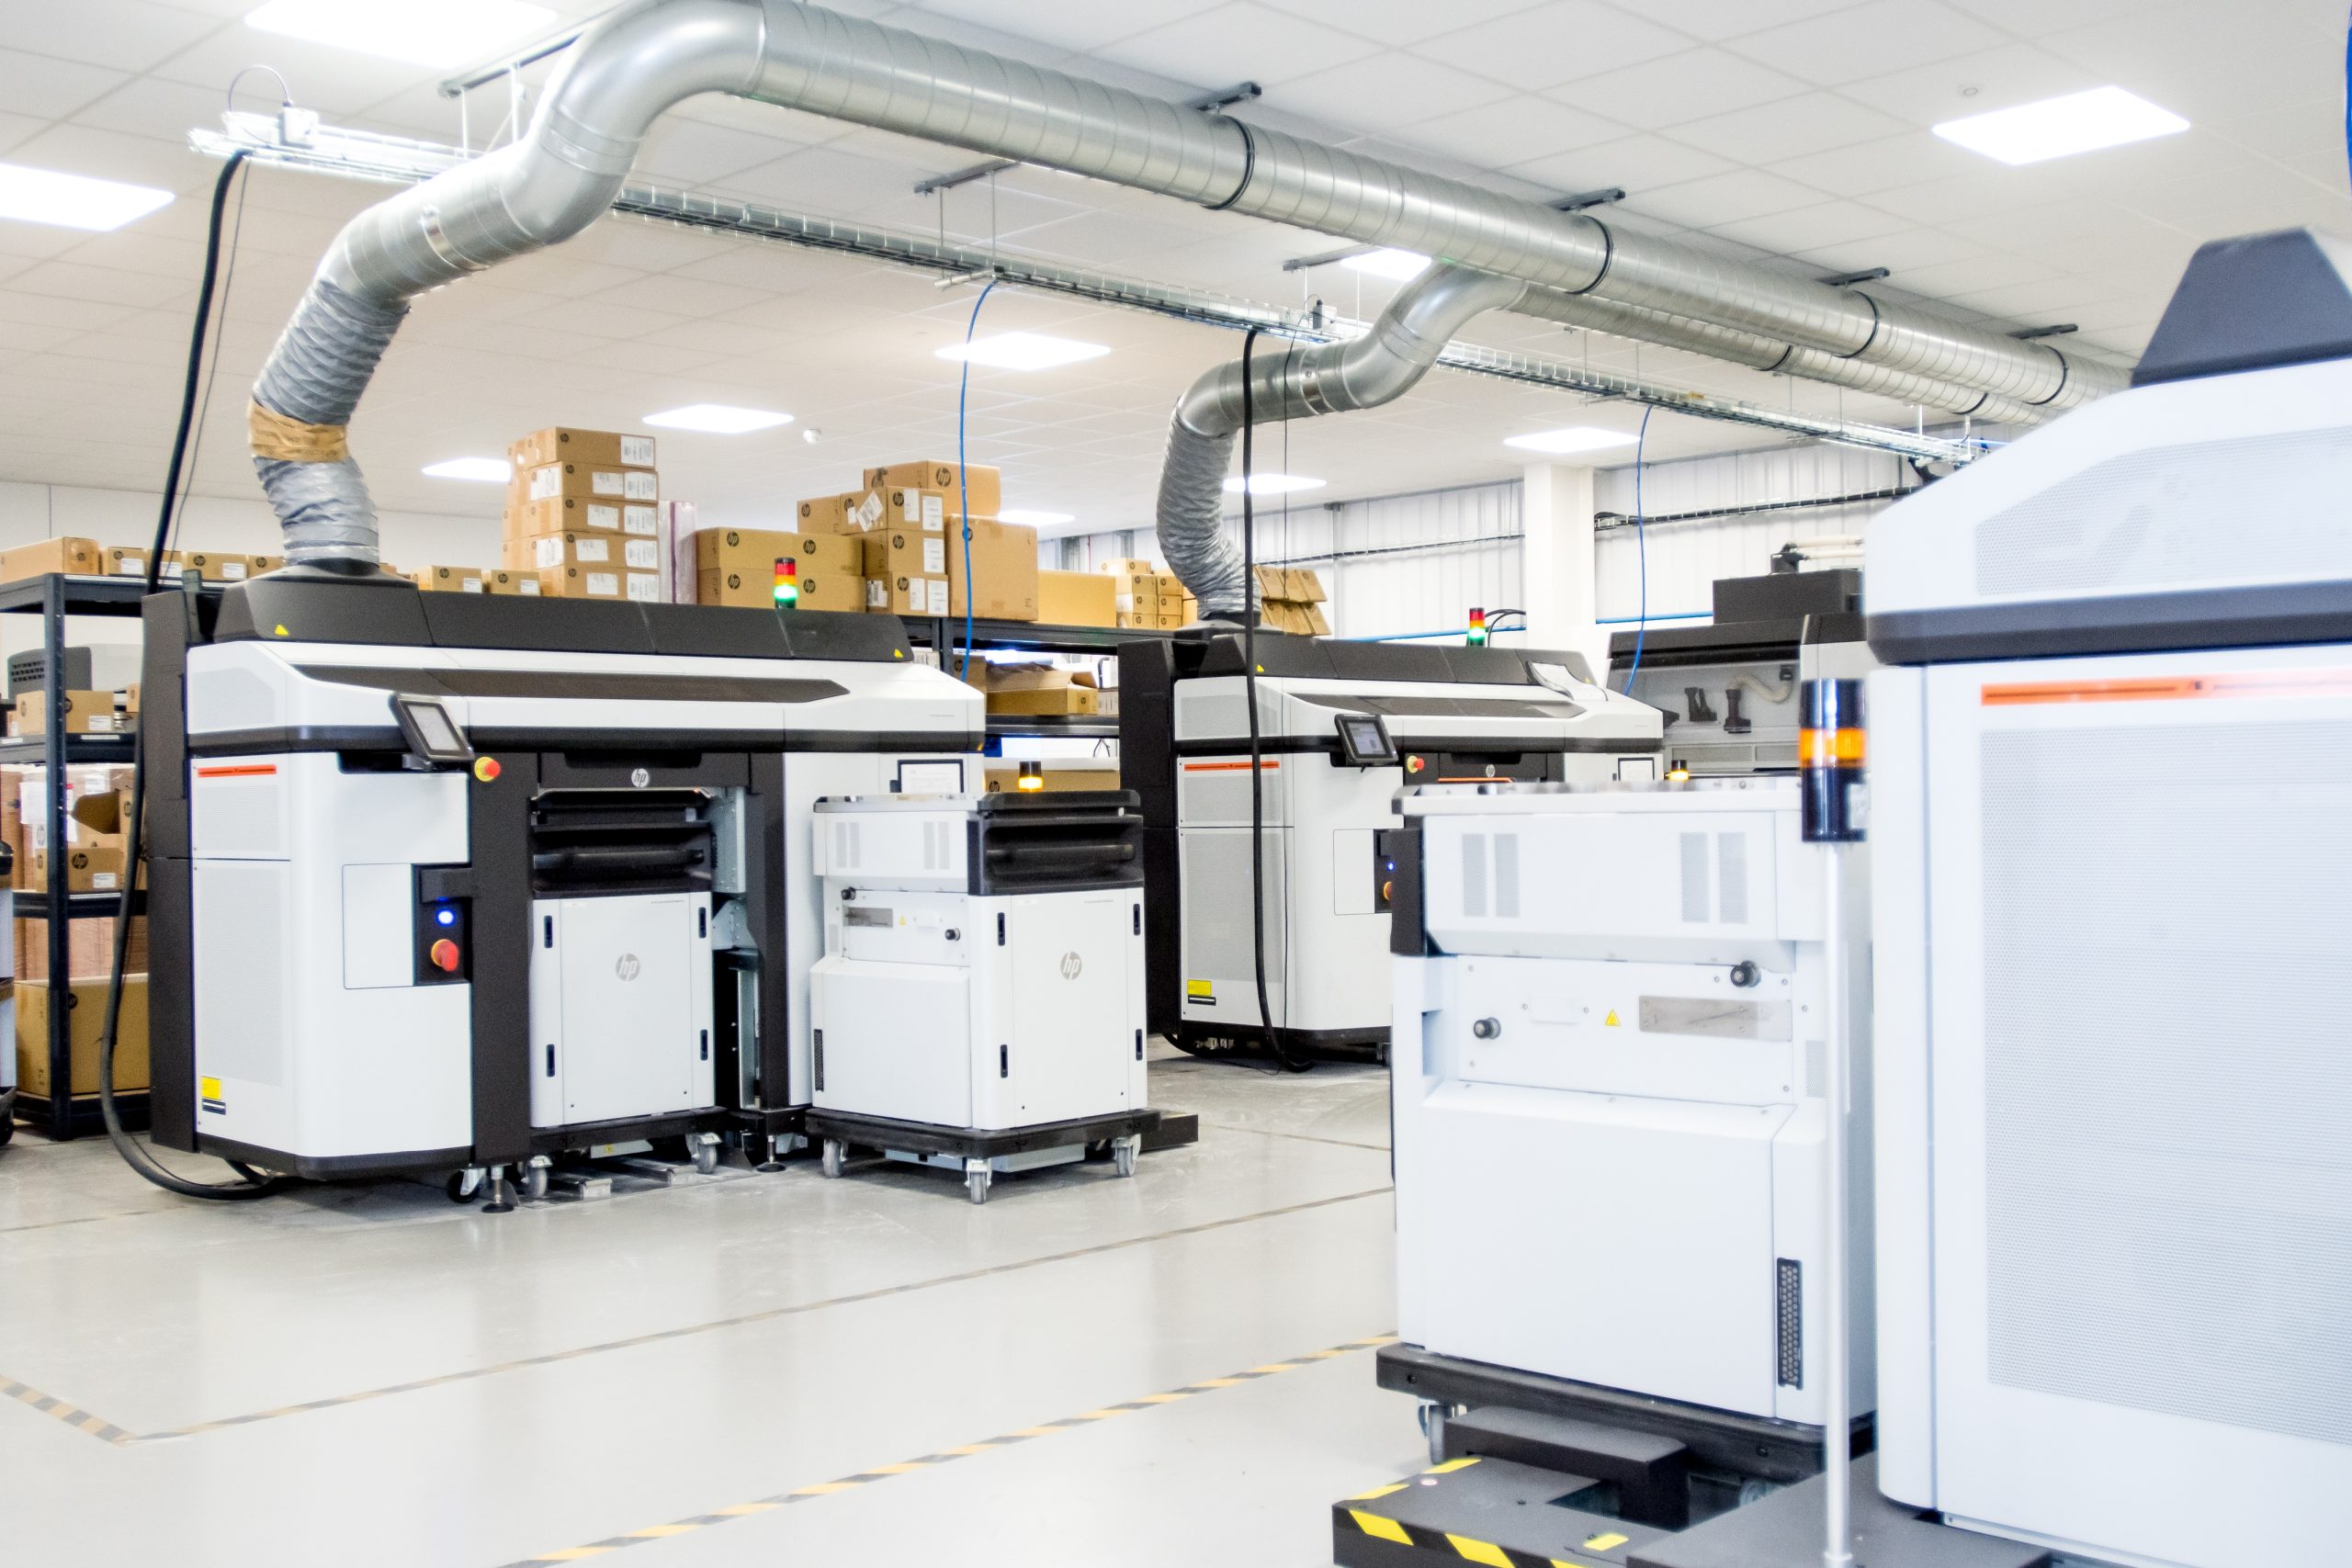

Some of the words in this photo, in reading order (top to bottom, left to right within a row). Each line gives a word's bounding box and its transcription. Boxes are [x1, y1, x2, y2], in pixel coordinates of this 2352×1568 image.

[937, 467, 950, 487] hp
[894, 491, 904, 506] hp
[728, 532, 738, 547] hp
[804, 539, 815, 555] hp
[894, 535, 903, 549] hp
[729, 574, 740, 589] hp
[804, 579, 815, 593] hp
[898, 577, 908, 592] hp
[633, 768, 647, 787] hp
[73, 853, 87, 870] hp
[616, 953, 639, 981] hp
[1062, 952, 1081, 980] hp
